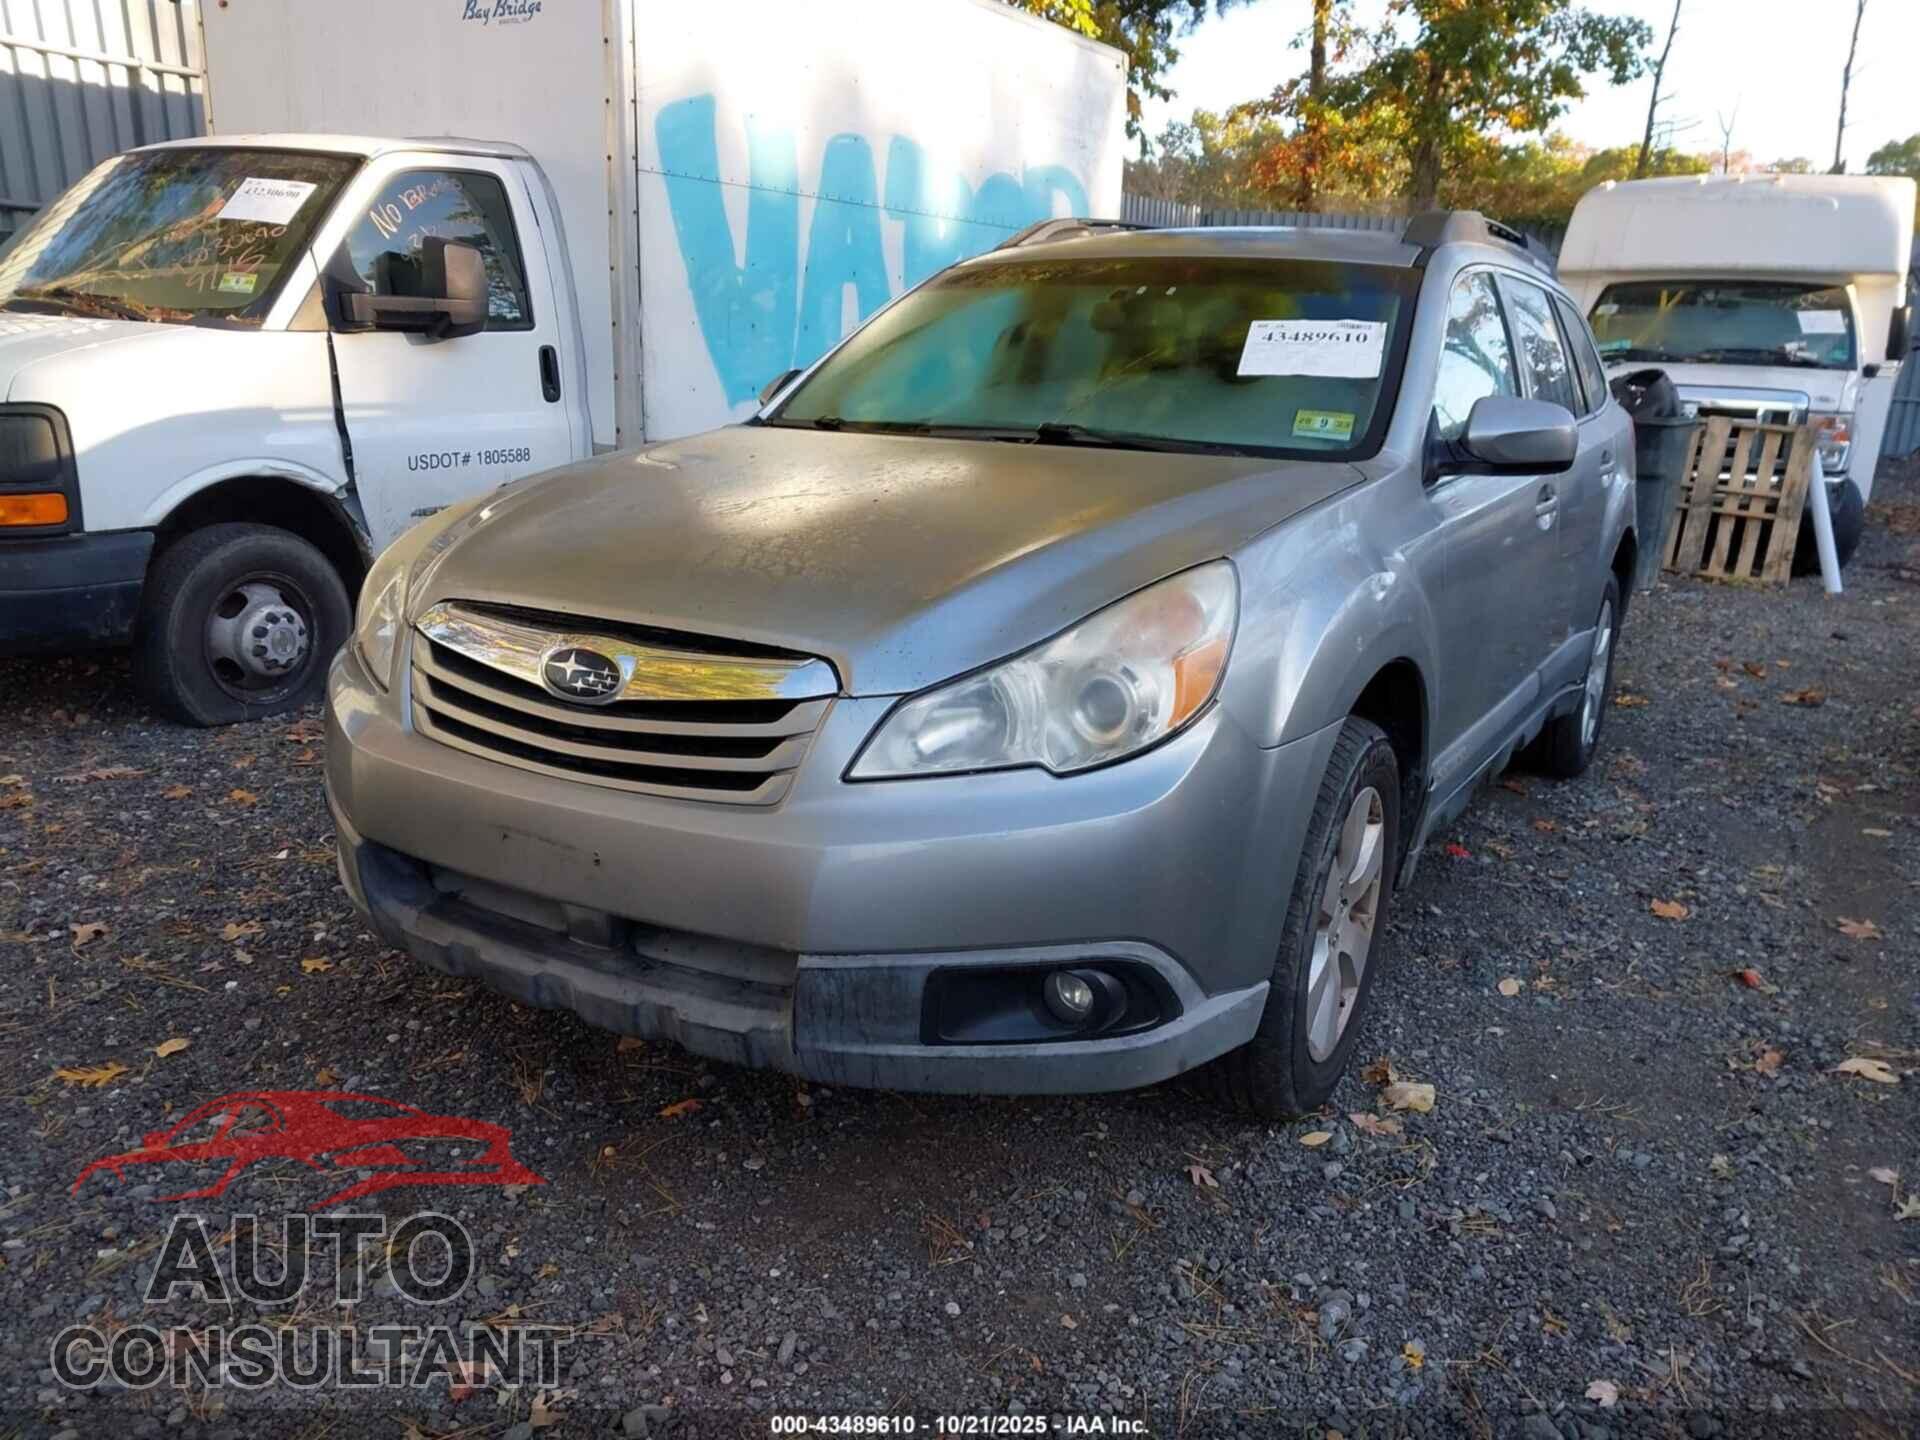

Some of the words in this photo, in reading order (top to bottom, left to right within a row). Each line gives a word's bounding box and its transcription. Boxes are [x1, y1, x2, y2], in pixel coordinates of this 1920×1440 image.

[463, 0, 491, 25] Bay
[493, 0, 542, 21] Bridge
[1261, 331, 1369, 343] 43489610
[407, 452, 471, 471] USDOT#
[476, 447, 531, 465] 1805588
